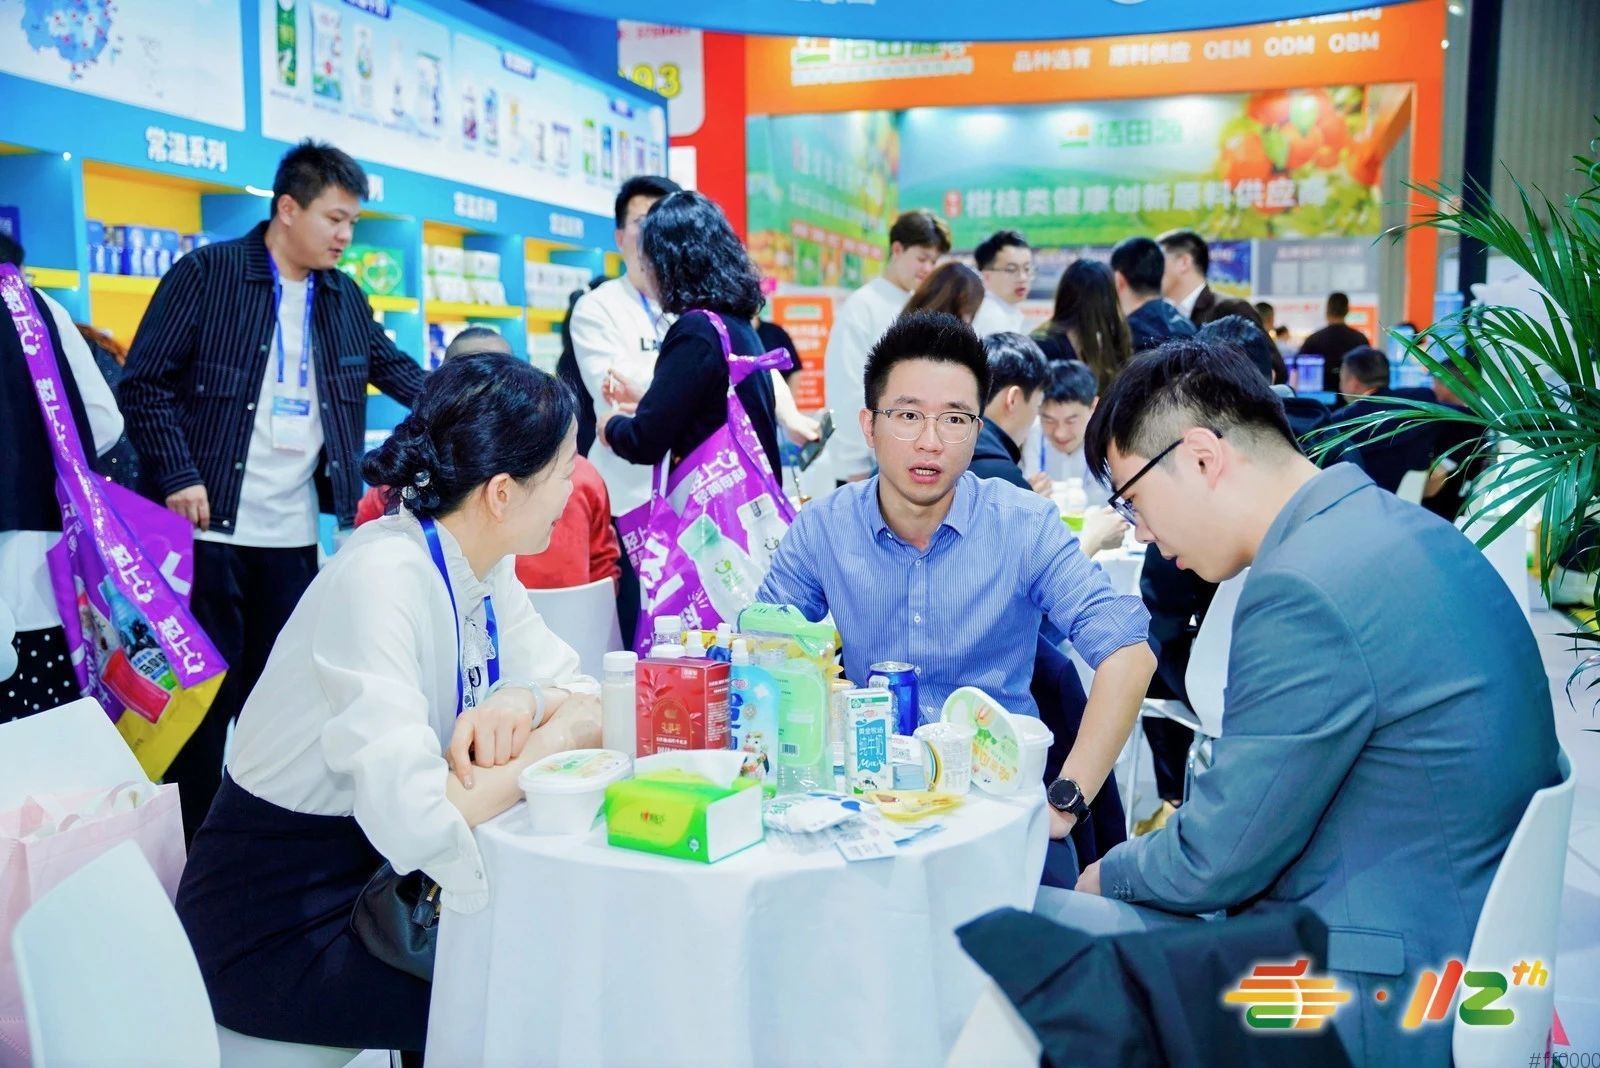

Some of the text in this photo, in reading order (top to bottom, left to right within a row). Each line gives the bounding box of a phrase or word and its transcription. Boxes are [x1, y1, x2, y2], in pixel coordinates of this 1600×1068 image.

[1012, 31, 1380, 73] 品种选育 原料供应 OEM ODM OBM
[145, 127, 228, 172] 常温系列
[966, 176, 1327, 219] 柑桔类健康创新原料供应商
